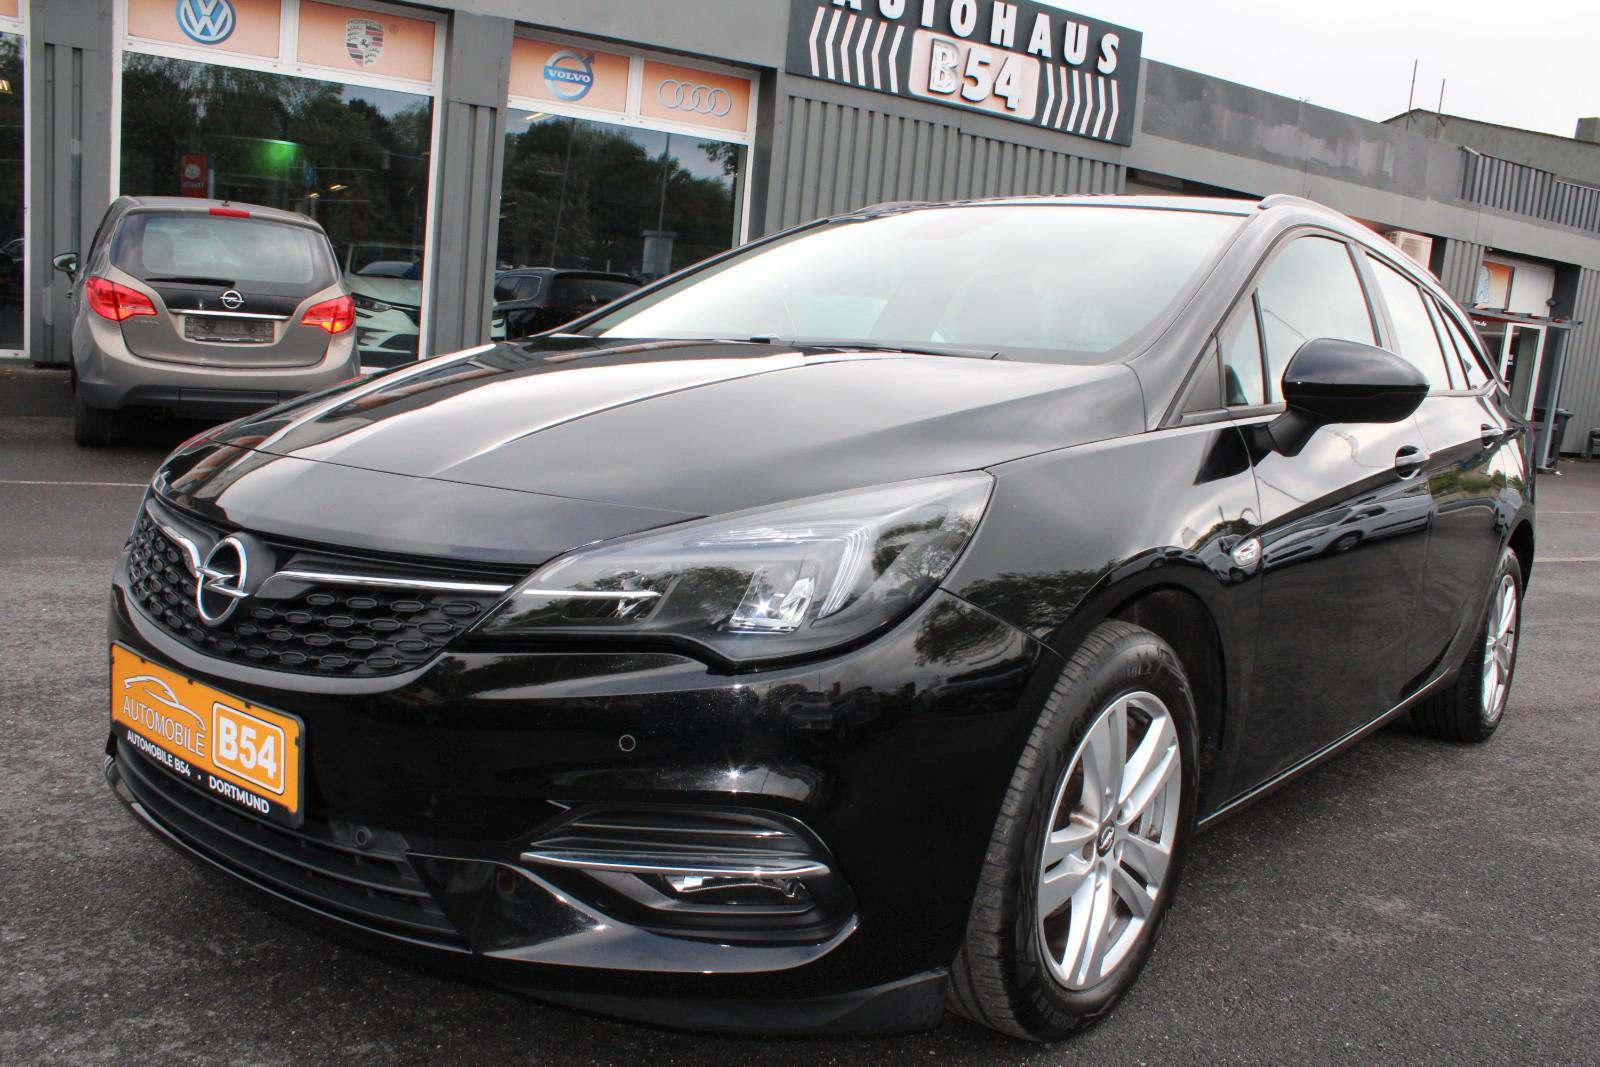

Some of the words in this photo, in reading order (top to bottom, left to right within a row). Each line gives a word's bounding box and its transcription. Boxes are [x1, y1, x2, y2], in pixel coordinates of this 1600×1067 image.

[548, 69, 591, 83] VOLVO
[928, 39, 1024, 110] B54
[123, 696, 206, 758] AUTOMOBILE
[219, 716, 277, 779] B54
[127, 729, 174, 768] AUTOMOBILE
[174, 757, 191, 777] B54
[209, 776, 270, 814] DORTMUND
